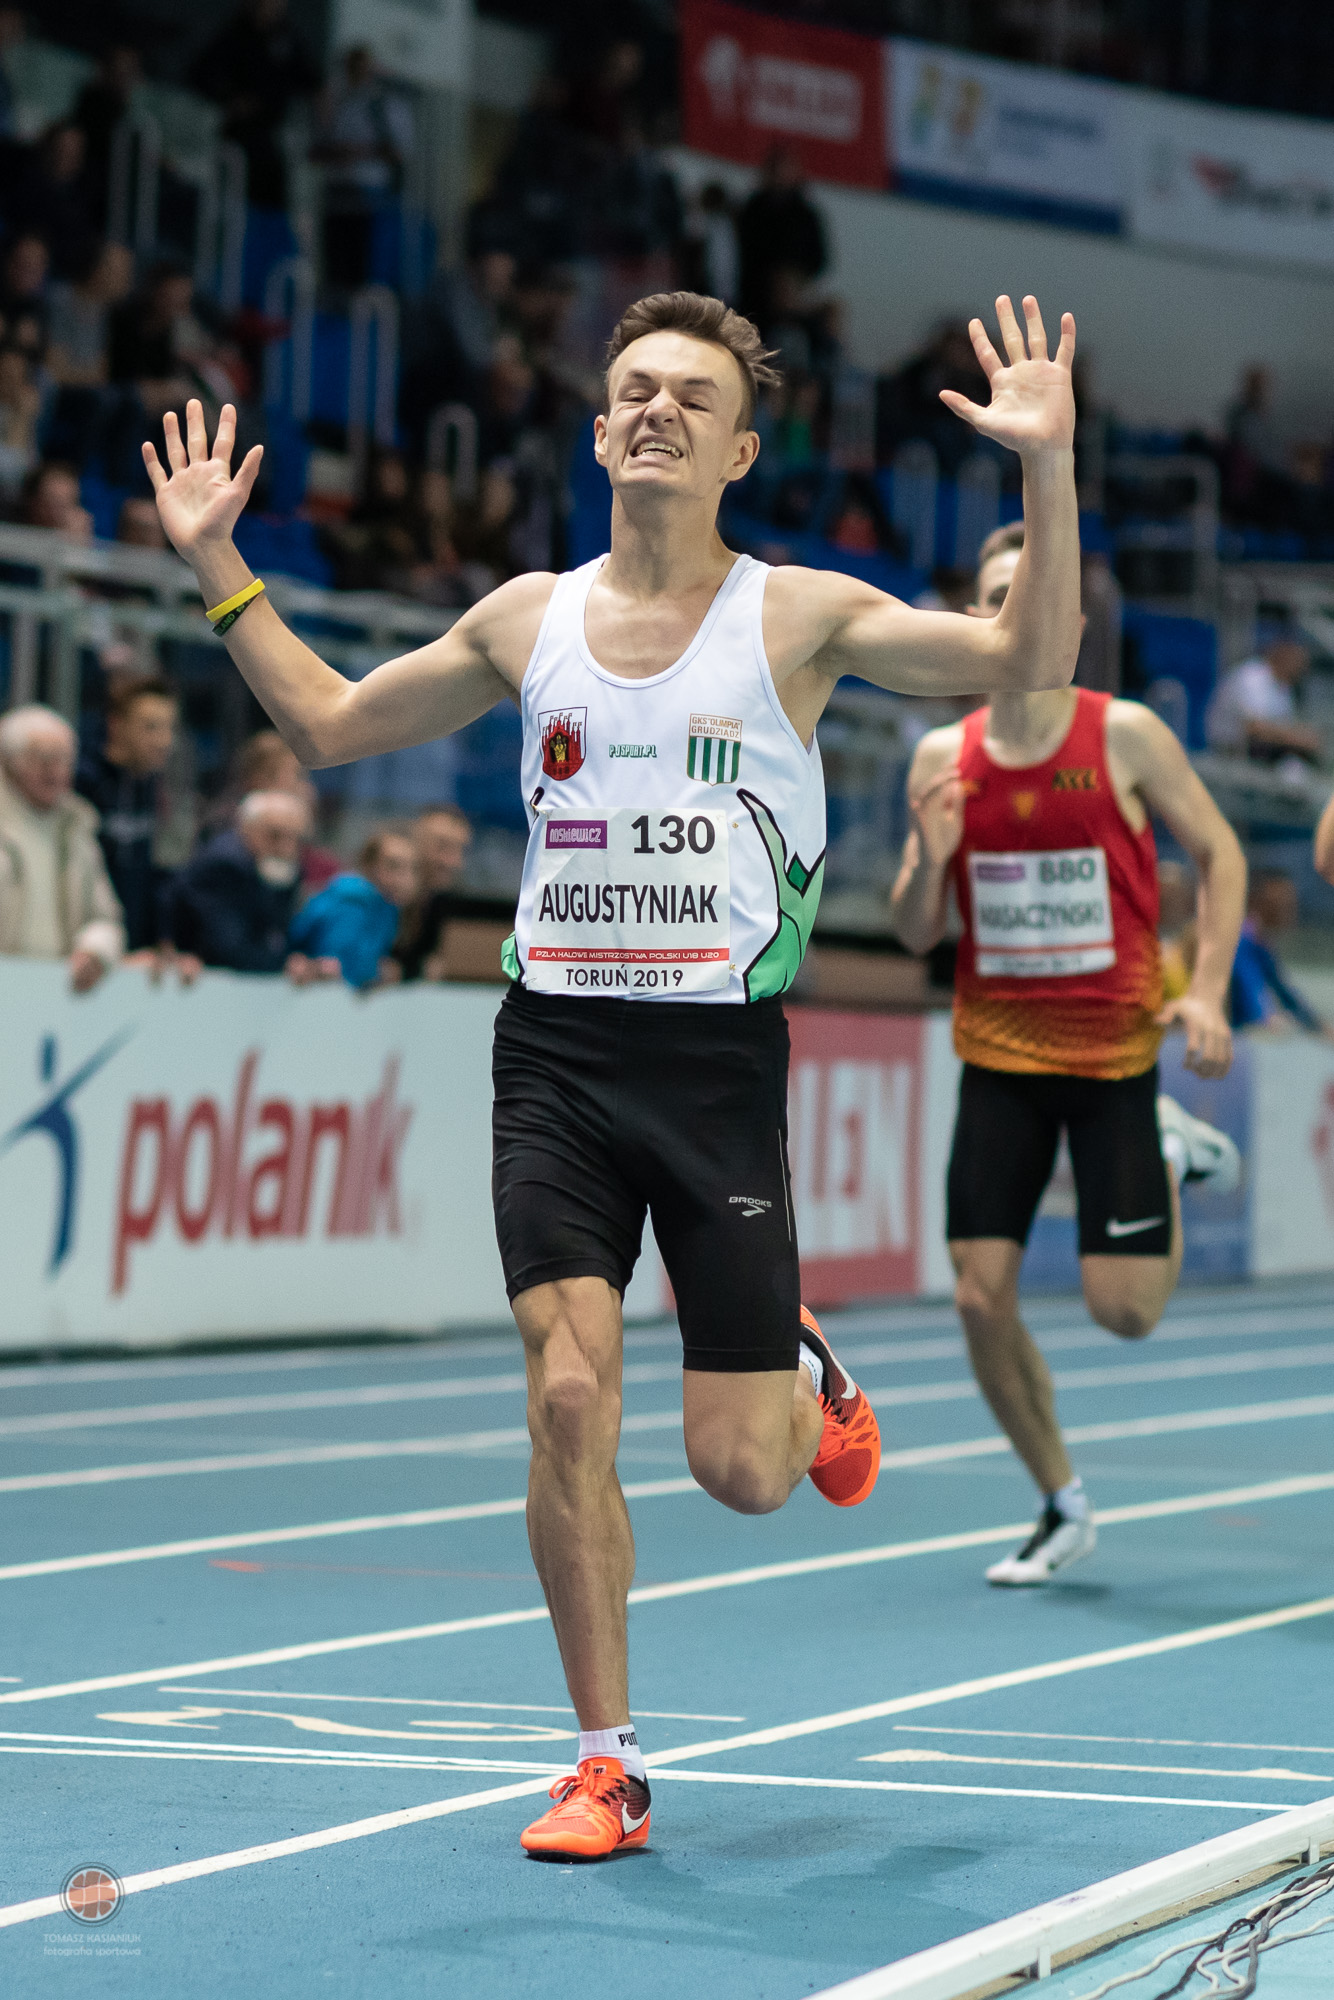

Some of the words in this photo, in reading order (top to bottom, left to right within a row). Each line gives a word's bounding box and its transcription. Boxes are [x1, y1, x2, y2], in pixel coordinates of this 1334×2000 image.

[692, 716, 708, 725] GKS
[631, 815, 716, 854] 130
[538, 884, 719, 923] AUGUSTYNIAK
[558, 952, 588, 960] HALOWE
[589, 952, 648, 960] MISTRZOSTWA
[649, 952, 681, 960] POLSKI
[566, 964, 628, 987] TORUŃ
[633, 969, 684, 988] 2019
[109, 1045, 412, 1299] polanik
[729, 1196, 772, 1208] BROOKS
